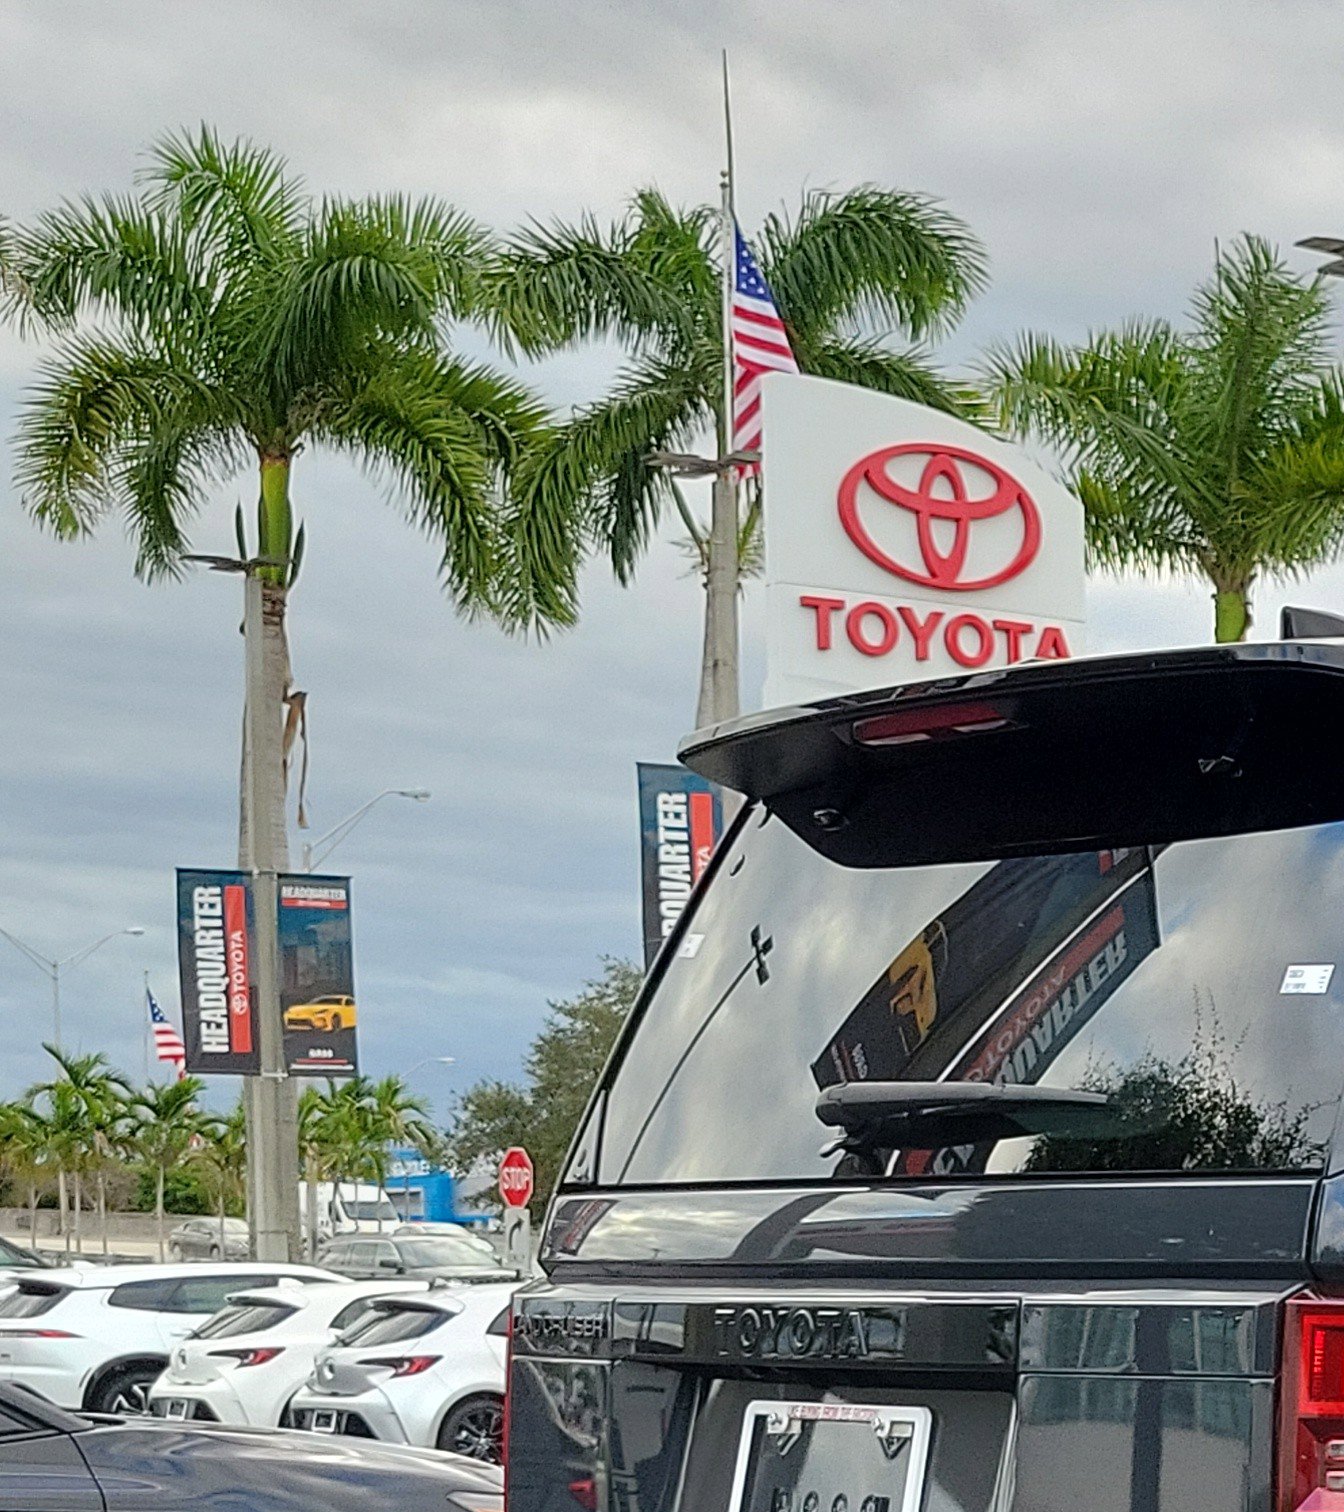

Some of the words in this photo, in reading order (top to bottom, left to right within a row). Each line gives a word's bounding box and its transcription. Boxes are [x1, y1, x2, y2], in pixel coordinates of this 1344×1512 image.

[799, 595, 1071, 669] TOYOTA
[193, 885, 230, 1053] HEADQUARTER
[231, 931, 246, 992] TOYOTA
[502, 1166, 530, 1190] STOP
[714, 1308, 870, 1358] TOYOTA
